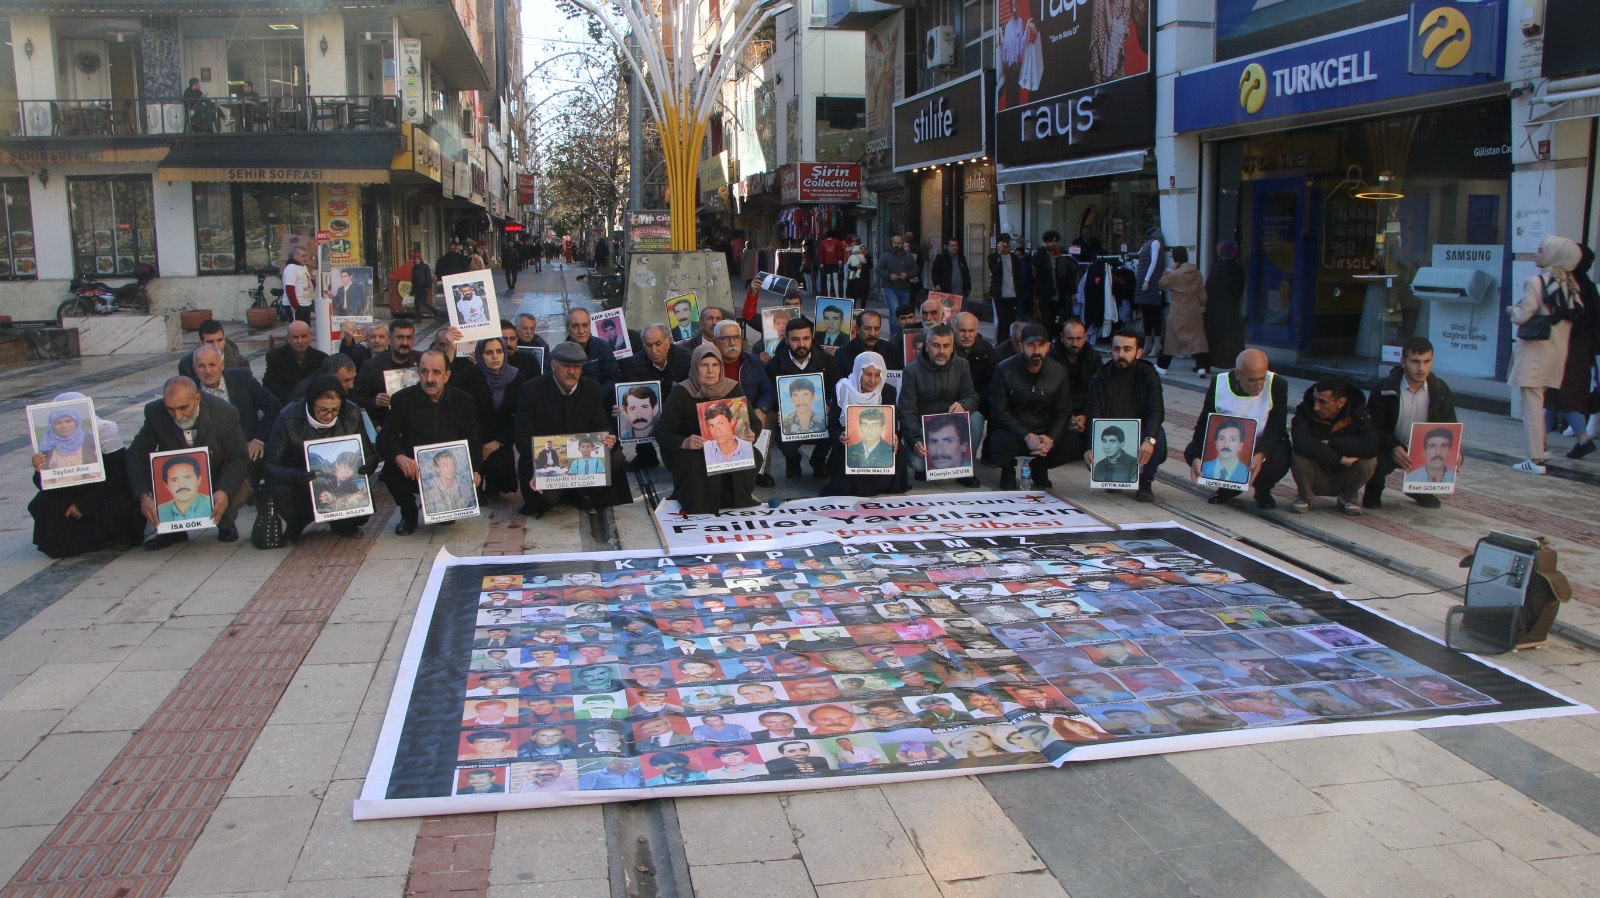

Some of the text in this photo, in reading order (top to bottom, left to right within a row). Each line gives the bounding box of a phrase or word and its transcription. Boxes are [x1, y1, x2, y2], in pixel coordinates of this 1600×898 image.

[1272, 50, 1378, 97] TURKCELL
[914, 97, 953, 144] stilife
[1021, 95, 1094, 146] rays
[1474, 148, 1500, 157] Gülistan
[269, 169, 323, 179] SOFRASI
[811, 165, 850, 179] Şirin
[803, 178, 857, 187] Collection
[1446, 250, 1491, 261] SAMSUNG
[857, 497, 1011, 510] Bulunsun
[185, 521, 202, 529] GÖK
[672, 507, 1087, 535] Failler Yargılansın
